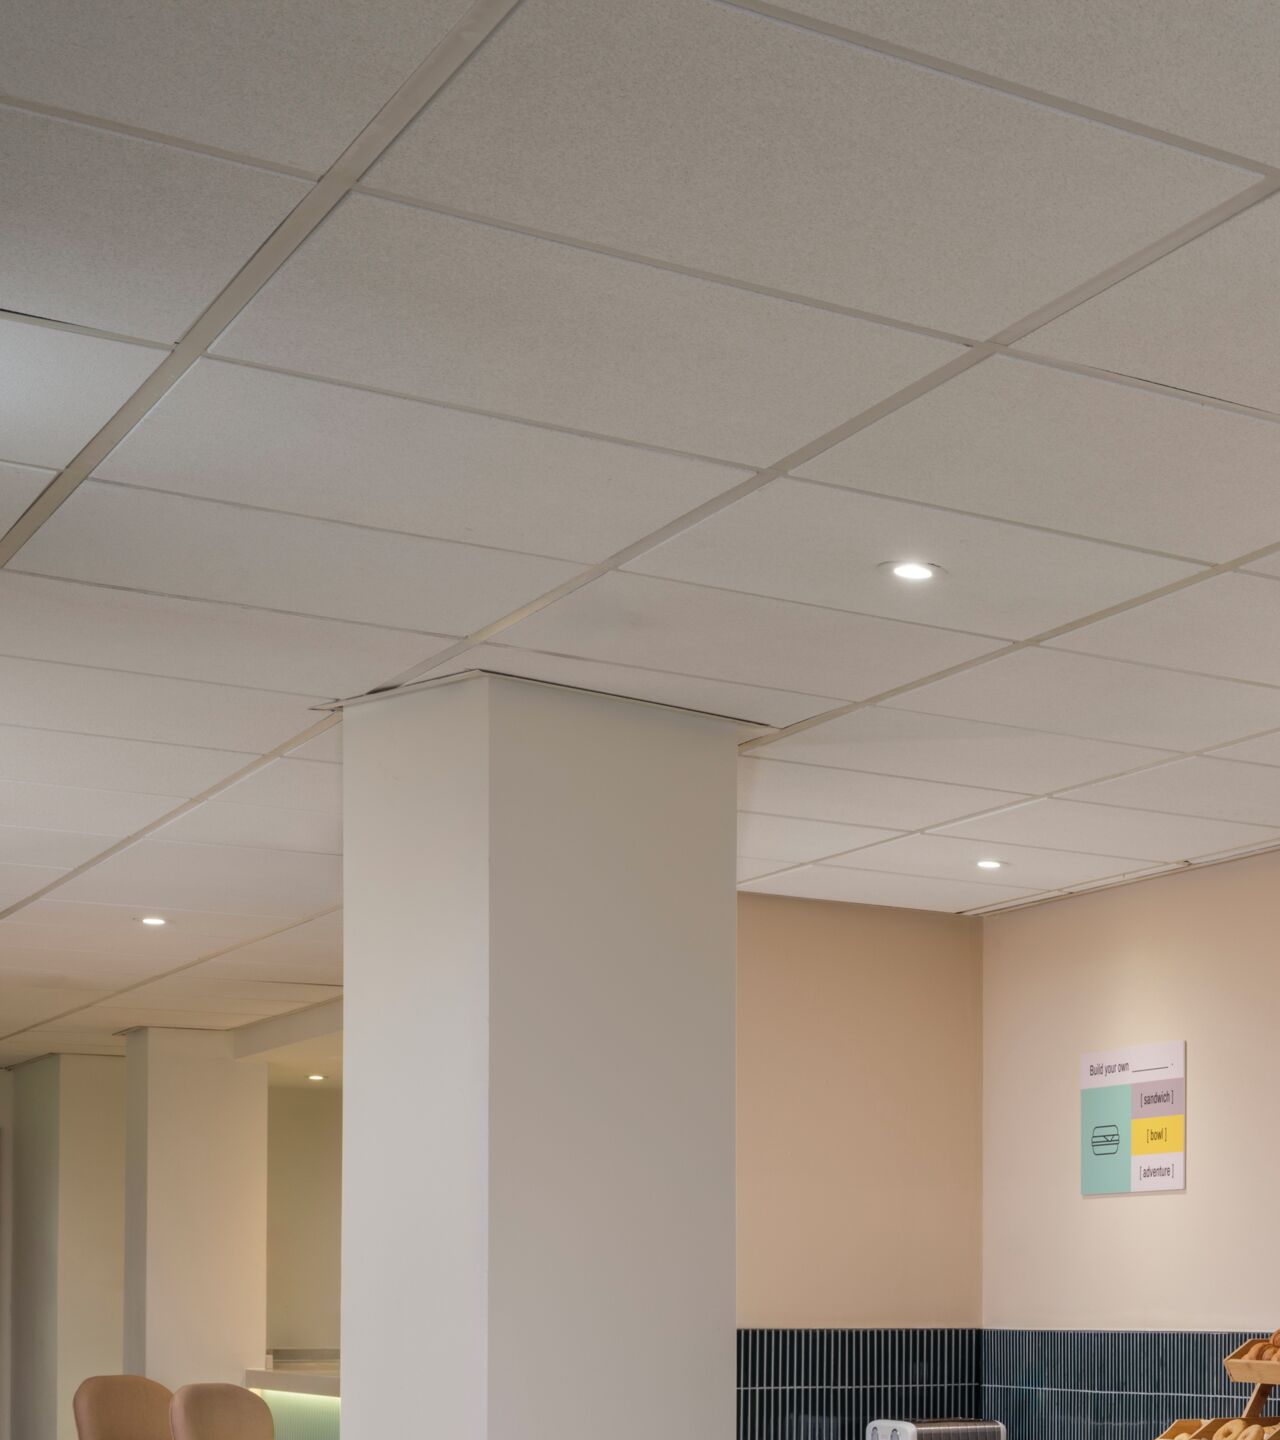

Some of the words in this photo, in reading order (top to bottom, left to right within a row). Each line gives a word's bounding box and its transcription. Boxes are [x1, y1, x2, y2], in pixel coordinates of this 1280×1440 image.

[1090, 1064, 1103, 1076] Build
[1104, 1064, 1117, 1077] your
[1118, 1062, 1129, 1073] own
